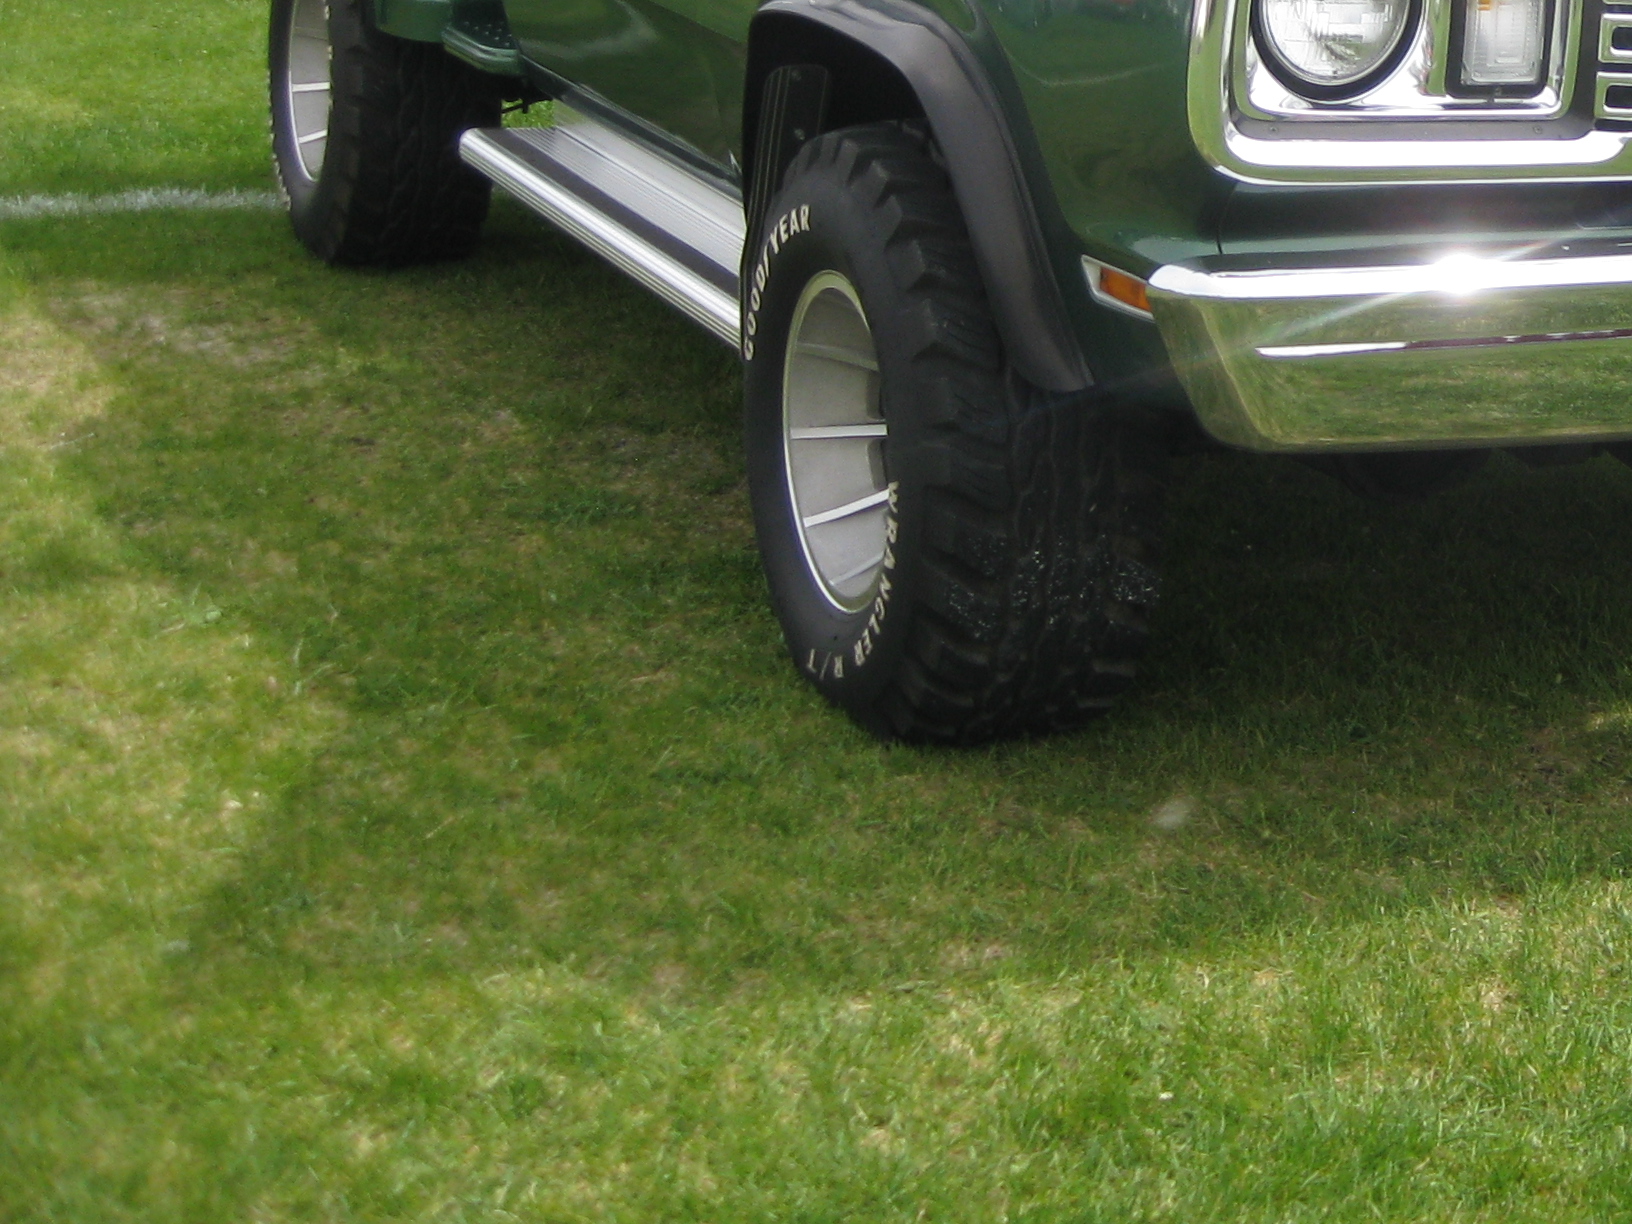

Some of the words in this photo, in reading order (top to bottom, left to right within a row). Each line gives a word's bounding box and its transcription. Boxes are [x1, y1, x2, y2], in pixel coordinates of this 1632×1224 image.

[743, 203, 811, 361] GOODYEAR
[855, 480, 900, 666] WRANGLER
[806, 648, 845, 681] R/T
